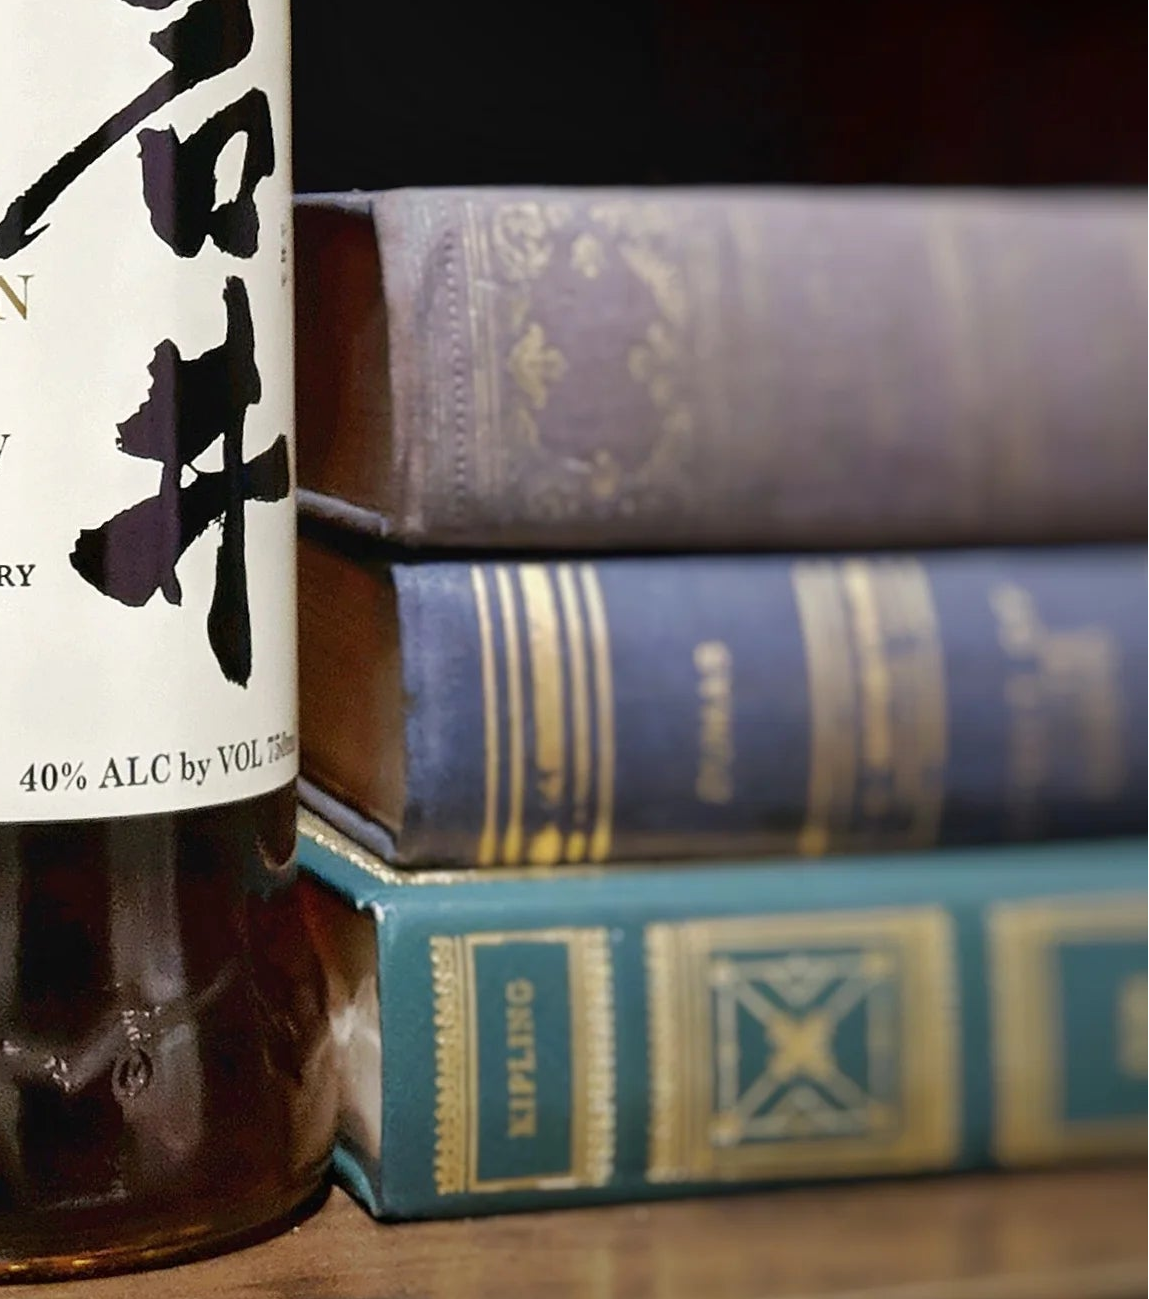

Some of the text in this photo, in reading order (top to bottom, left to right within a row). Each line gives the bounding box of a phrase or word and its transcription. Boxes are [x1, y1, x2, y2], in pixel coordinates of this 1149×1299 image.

[19, 761, 88, 793] 40%
[98, 752, 172, 791] ALC
[180, 750, 212, 786] by
[217, 738, 263, 775] VOL
[504, 979, 537, 1138] KIPLING
